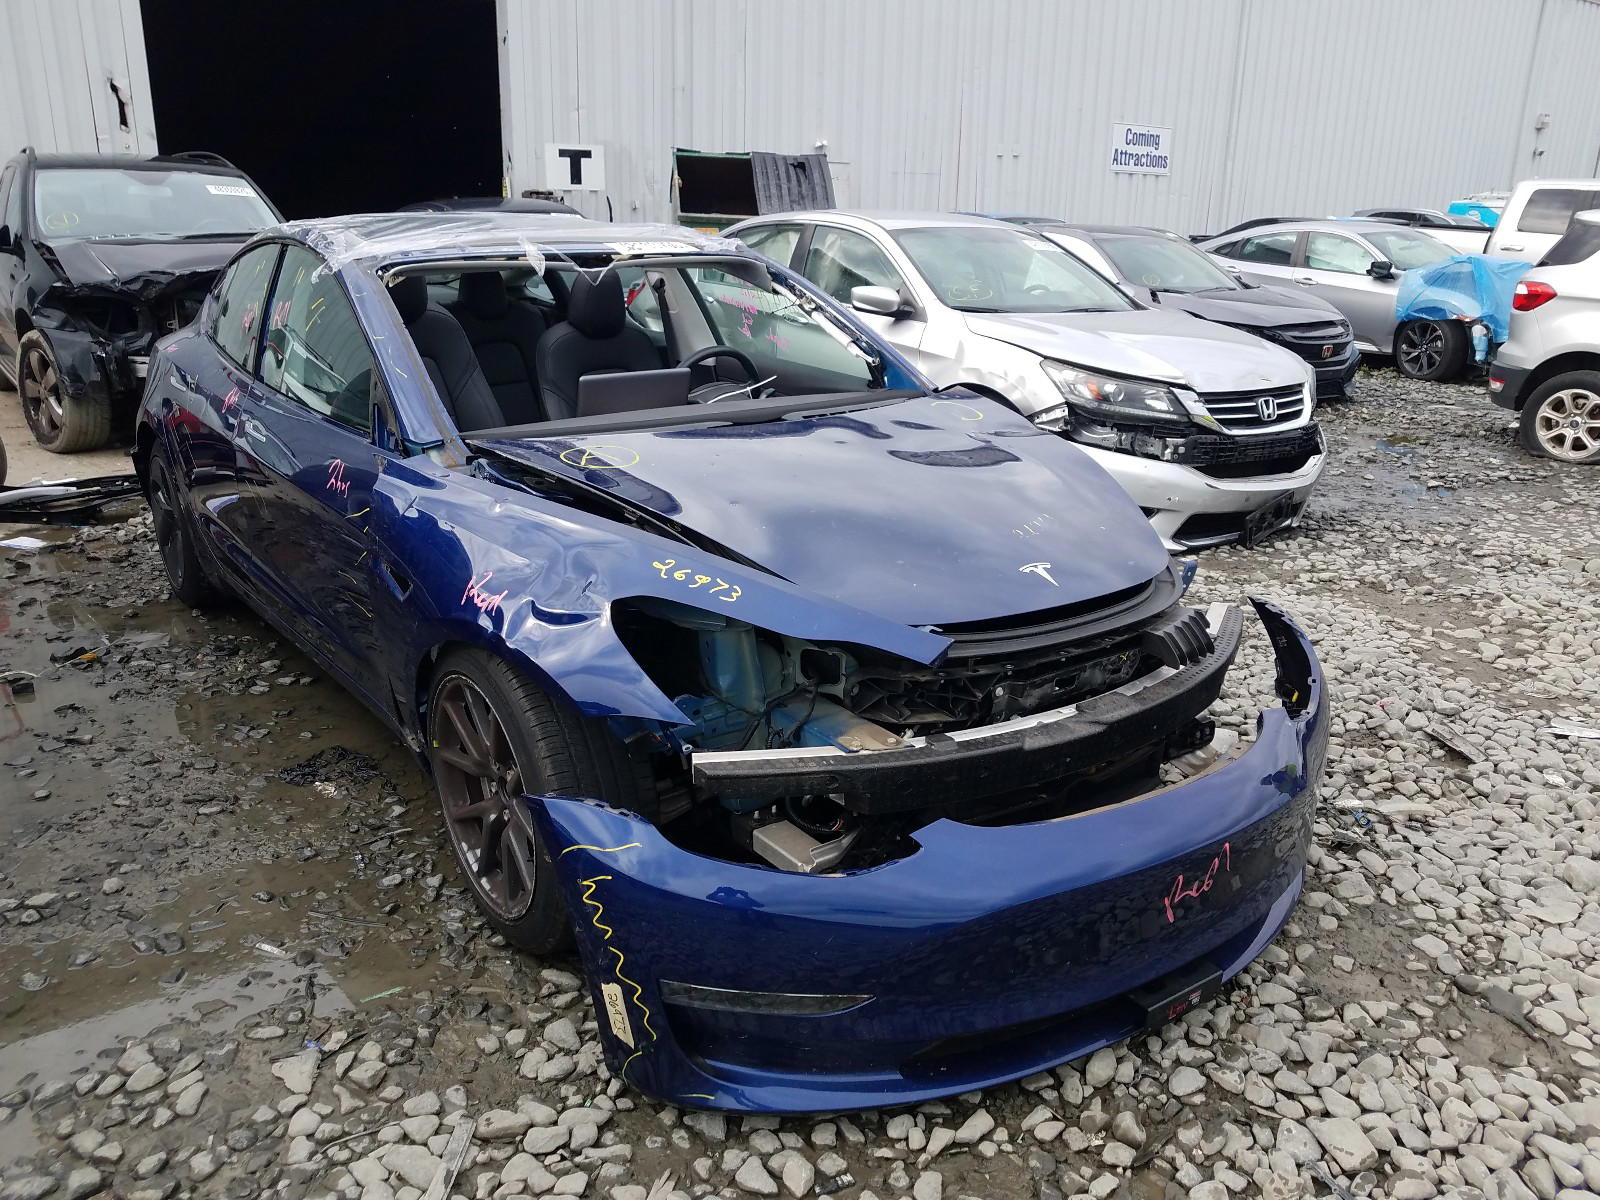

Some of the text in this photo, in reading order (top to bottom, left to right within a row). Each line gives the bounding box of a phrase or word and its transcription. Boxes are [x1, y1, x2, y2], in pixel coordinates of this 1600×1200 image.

[1125, 128, 1160, 150] Coming
[558, 148, 592, 185] T
[1112, 148, 1168, 169] Attractions
